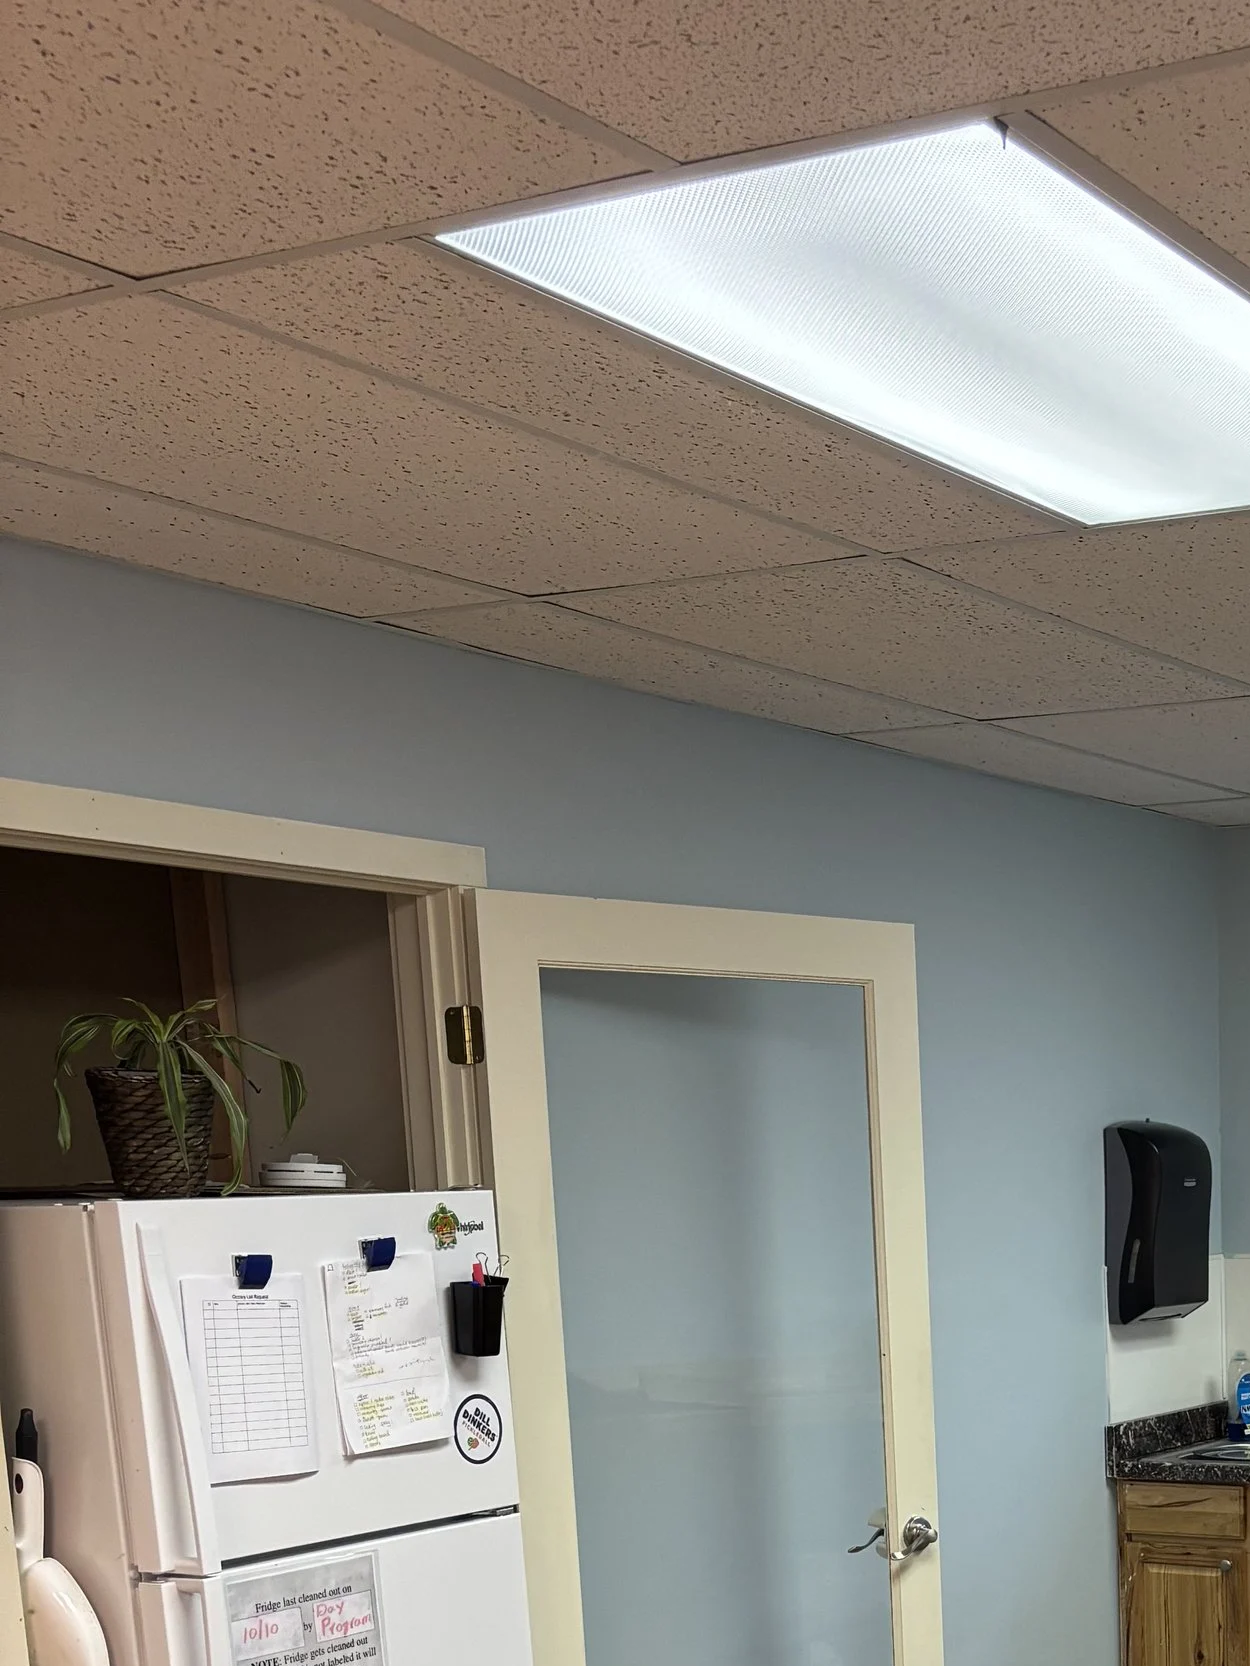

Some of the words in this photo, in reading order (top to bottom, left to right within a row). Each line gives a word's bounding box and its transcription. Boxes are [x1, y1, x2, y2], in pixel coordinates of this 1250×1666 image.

[462, 1409, 496, 1442] DINKERS
[474, 1407, 491, 1427] DILL
[462, 1420, 491, 1448] PICKLEBALL
[255, 1601, 281, 1613] Fridge
[283, 1597, 297, 1607] last
[298, 1589, 327, 1604] cleaned
[329, 1587, 341, 1597] out
[342, 1585, 352, 1594] on
[316, 1601, 344, 1618] Day
[244, 1619, 279, 1644] 10/10
[303, 1622, 313, 1633] by
[321, 1614, 372, 1638] Program
[284, 1652, 309, 1665] Fridge
[310, 1647, 326, 1660] gets
[327, 1641, 355, 1654] cleaned
[357, 1636, 369, 1647] out
[356, 1651, 361, 1660] it
[363, 1647, 377, 1658] will
